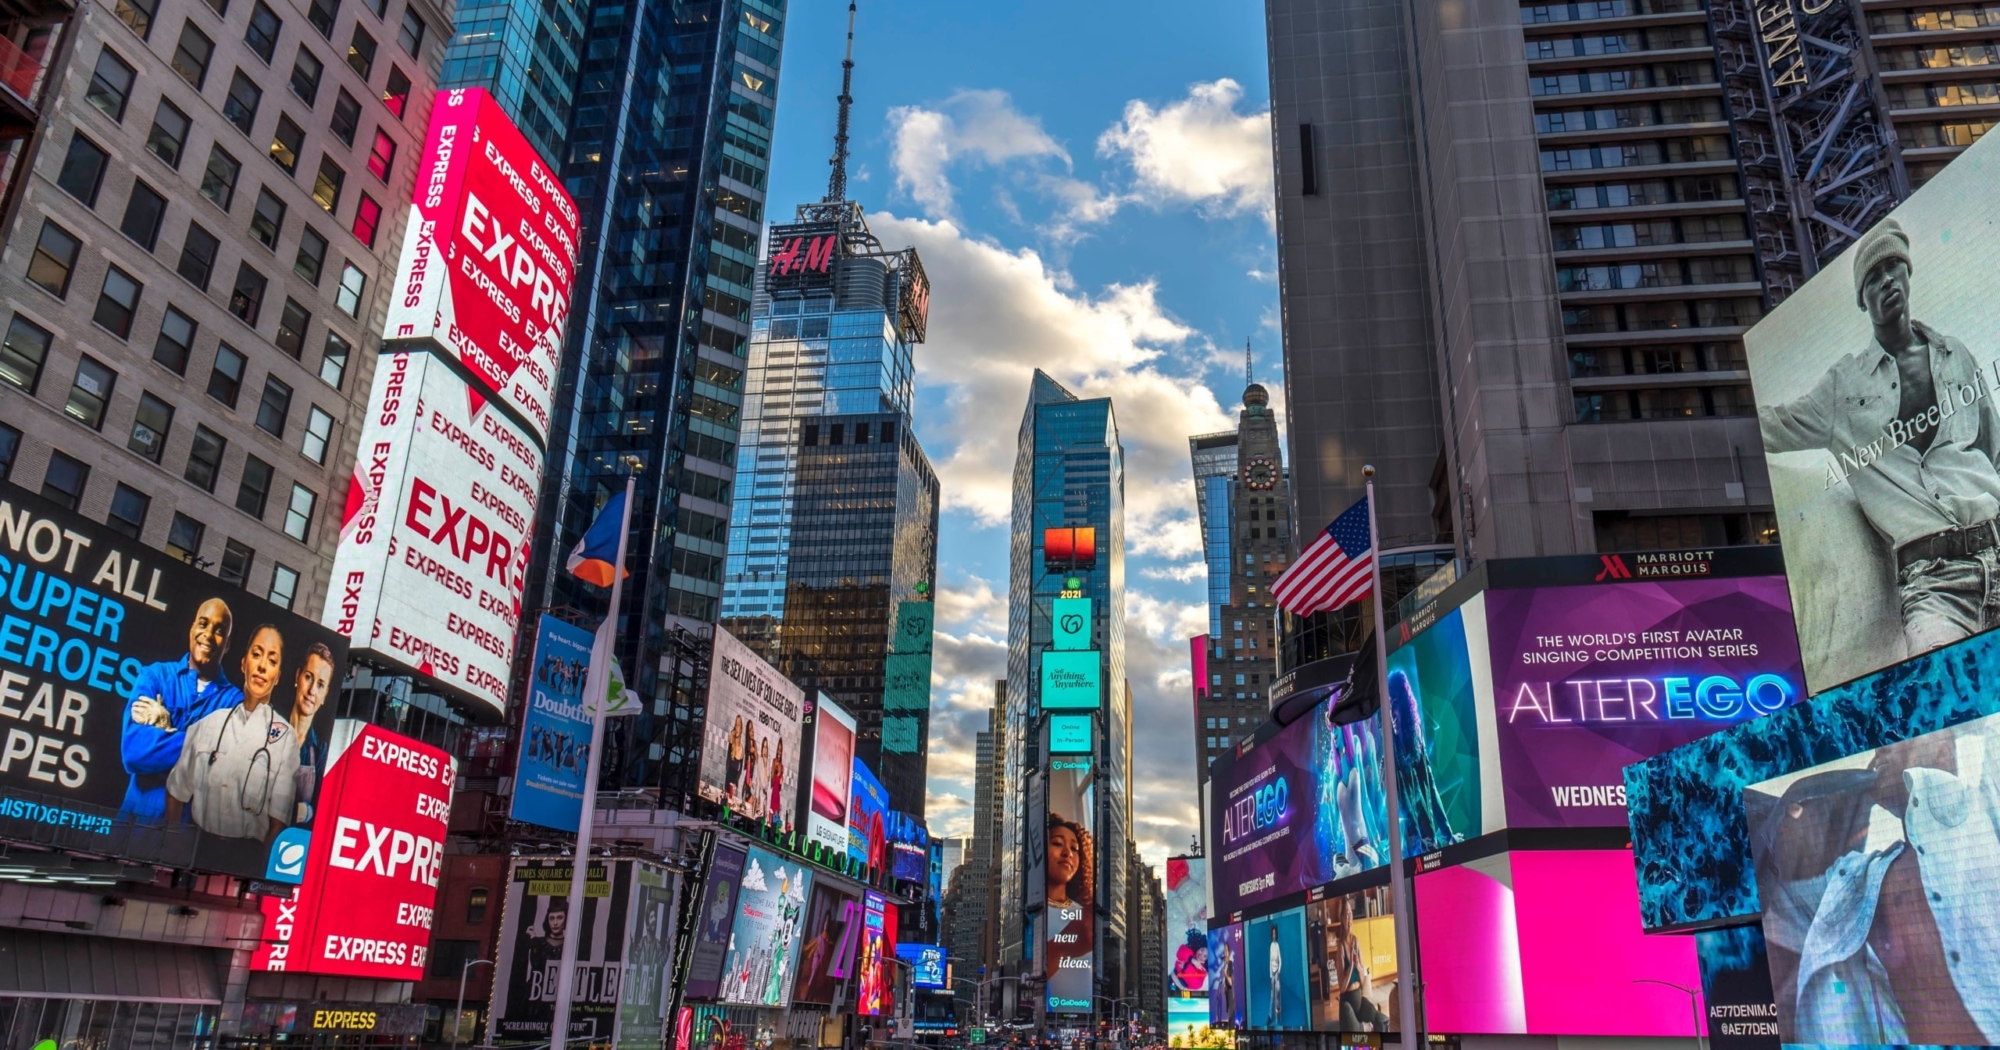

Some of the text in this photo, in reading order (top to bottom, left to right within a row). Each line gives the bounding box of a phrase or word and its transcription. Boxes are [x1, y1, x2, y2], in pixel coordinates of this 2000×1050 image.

[426, 125, 456, 208] EXPRESS
[485, 140, 539, 214] EXPRESS
[530, 161, 576, 229] EXPRESS
[405, 221, 436, 308] EXPRESS
[520, 219, 567, 284] EXPRESS
[770, 235, 836, 276] H&M
[462, 255, 520, 324] EXPRESS
[911, 273, 929, 326] H&M
[448, 323, 508, 390] EXPRESS
[498, 330, 548, 391] EXPRESS
[431, 410, 495, 471] EXPRESS
[484, 414, 536, 471] EXPRESS
[1824, 461, 1841, 490] A
[1840, 437, 1885, 478] New
[1887, 383, 1957, 451] Breed
[1959, 368, 1987, 407] of
[356, 442, 391, 545] EXPRESS
[471, 481, 525, 535] EXPRESS
[0, 501, 168, 612] NOT ALL
[405, 546, 472, 600] EXPRESS
[1637, 551, 1714, 564] MARRIOTT
[1639, 562, 1707, 575] MARQUIS
[0, 558, 125, 644] SUPER
[1061, 590, 1081, 599] 2021
[1411, 599, 1437, 624] MARRIOTT
[447, 612, 504, 659] EXPRESS
[1412, 613, 1435, 635] MARQUIS
[1537, 628, 1743, 648] THE WORLD'S FIRST AVATAR
[0, 613, 142, 701] EROES
[389, 626, 459, 676] EXPRESS
[1522, 644, 1759, 664] SINGING COMPETITION SERIES
[0, 670, 89, 736] EAR
[730, 658, 741, 682] SEX
[741, 667, 757, 693] LIVES
[756, 678, 764, 697] OF
[763, 683, 785, 713] COLLEGE
[784, 699, 797, 722] GIRLS
[362, 735, 437, 779] EXPRESS
[1063, 761, 1090, 769] GoDaddy
[1552, 785, 1627, 807] WEDNES
[761, 817, 809, 857] 1540
[816, 824, 823, 836] LG
[822, 828, 845, 848] SIGNATURE
[517, 868, 605, 880] TIMES SQUARE CA ALLY
[530, 883, 550, 893] MAKE
[553, 883, 567, 893] YOU
[1054, 933, 1077, 942] new
[1060, 909, 1082, 921] Sell
[324, 935, 406, 966] EXPRESS
[1058, 956, 1091, 969] ideas.
[529, 966, 617, 1001] BETLE
[1060, 998, 1090, 1008] GoDaddy
[313, 1010, 376, 1030] EXPRESS
